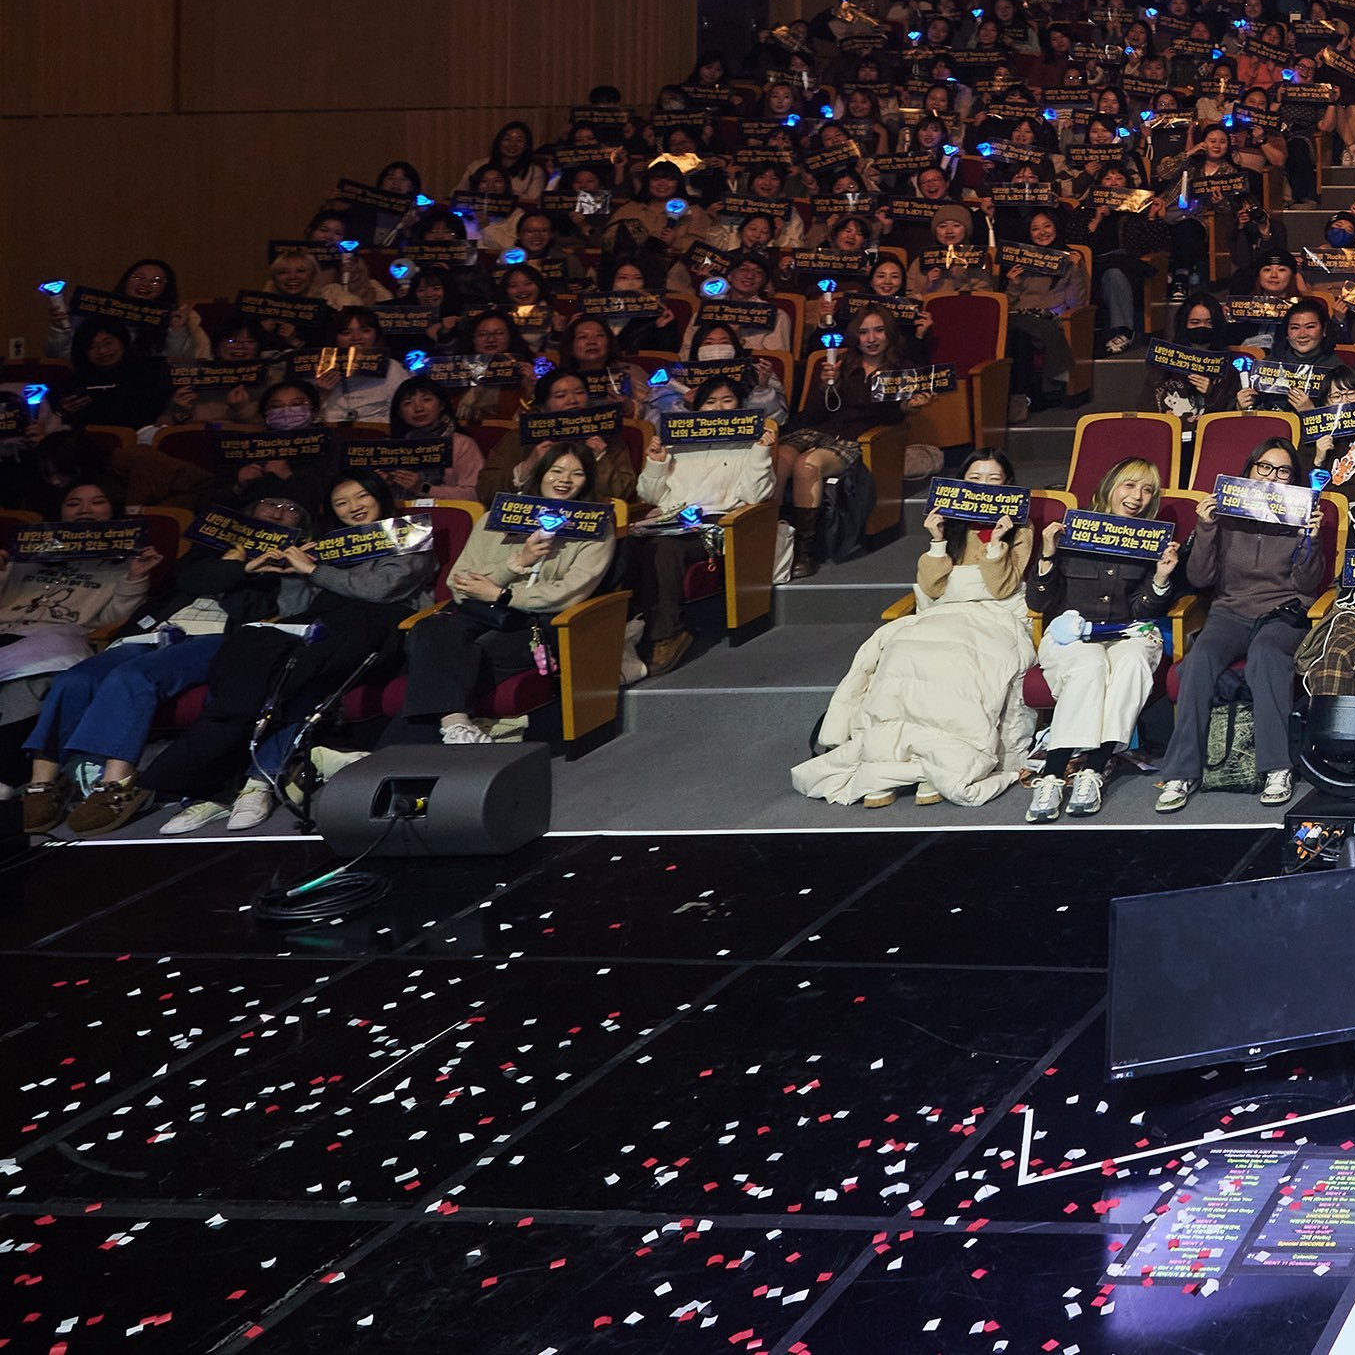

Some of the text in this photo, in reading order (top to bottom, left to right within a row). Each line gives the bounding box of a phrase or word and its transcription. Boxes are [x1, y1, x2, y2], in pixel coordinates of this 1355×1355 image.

[669, 419, 694, 429] 내인생
[696, 417, 729, 429] "Rucky
[671, 426, 755, 437] 너의 노래가 있는 지금
[936, 487, 961, 498] 내인생
[963, 489, 995, 503] "Rucky
[935, 499, 1019, 515] 너의 노래가 있는 지금
